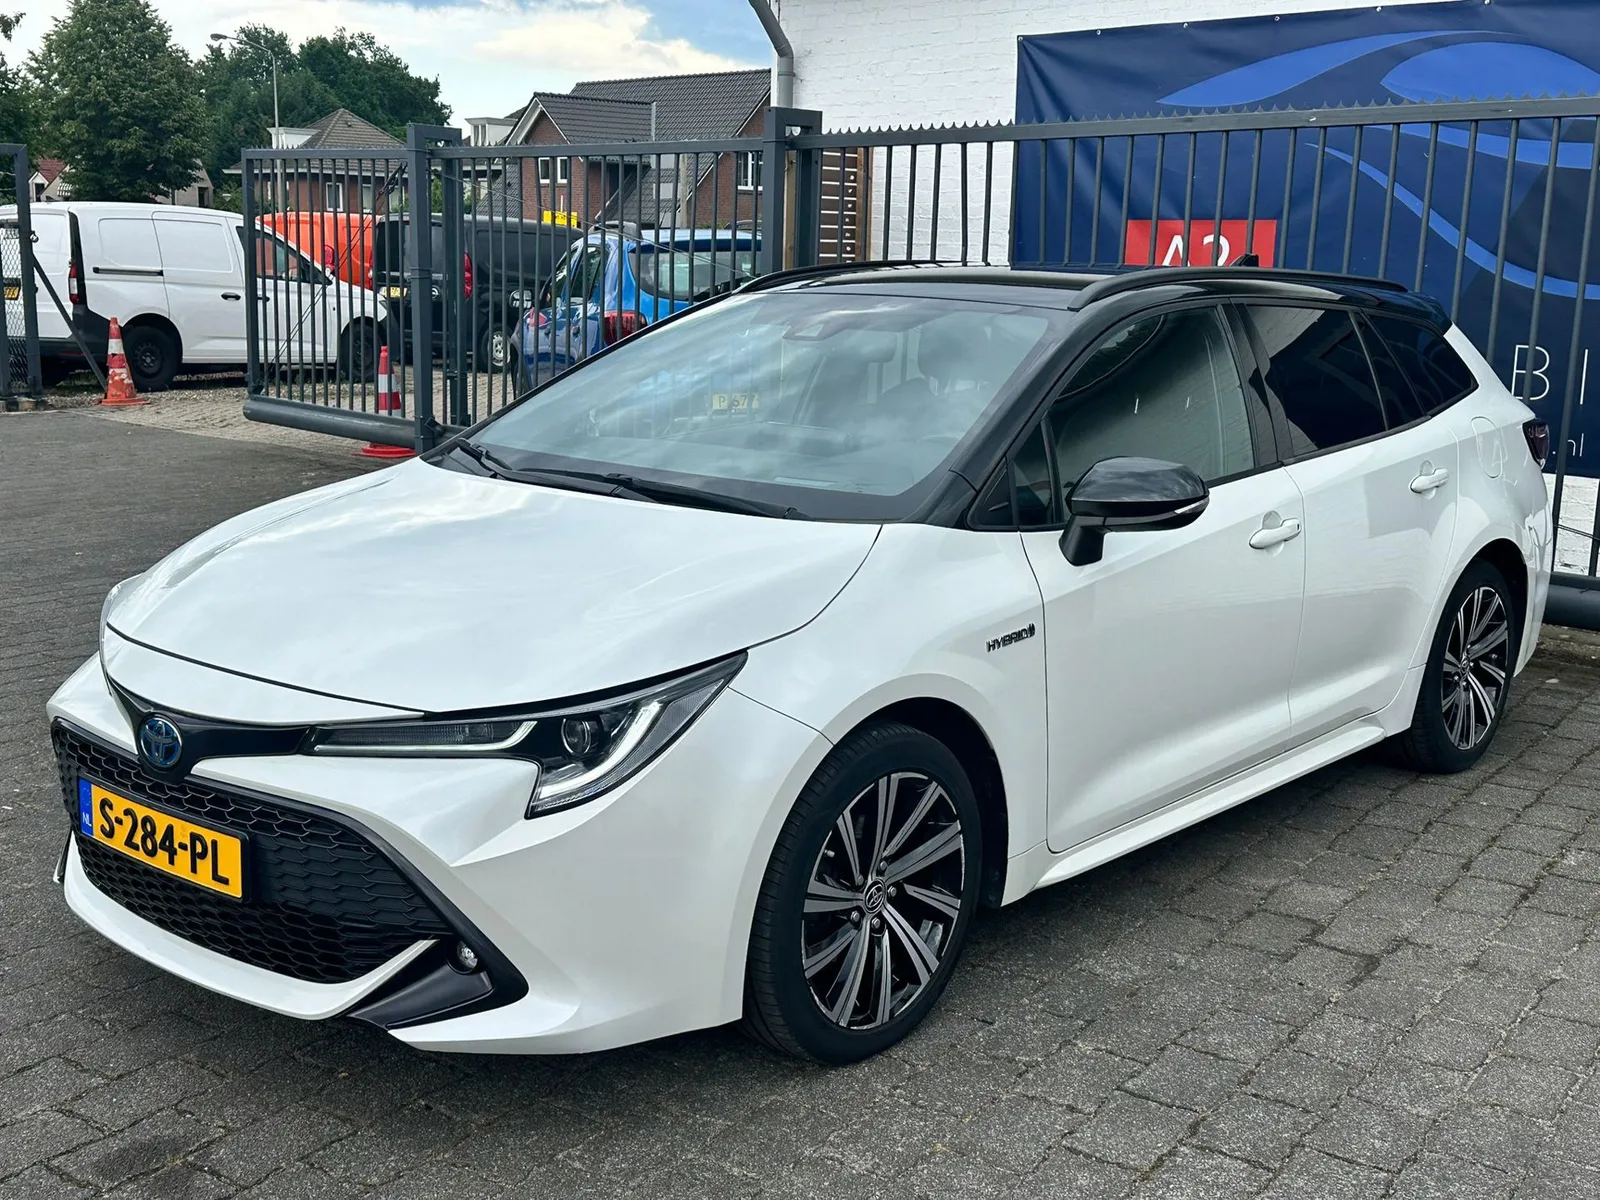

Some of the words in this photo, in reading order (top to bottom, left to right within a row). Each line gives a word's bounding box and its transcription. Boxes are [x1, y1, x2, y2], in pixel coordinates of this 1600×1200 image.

[985, 625, 1031, 653] HYBRID
[82, 811, 92, 827] NL
[99, 797, 230, 886] S-284-PL
